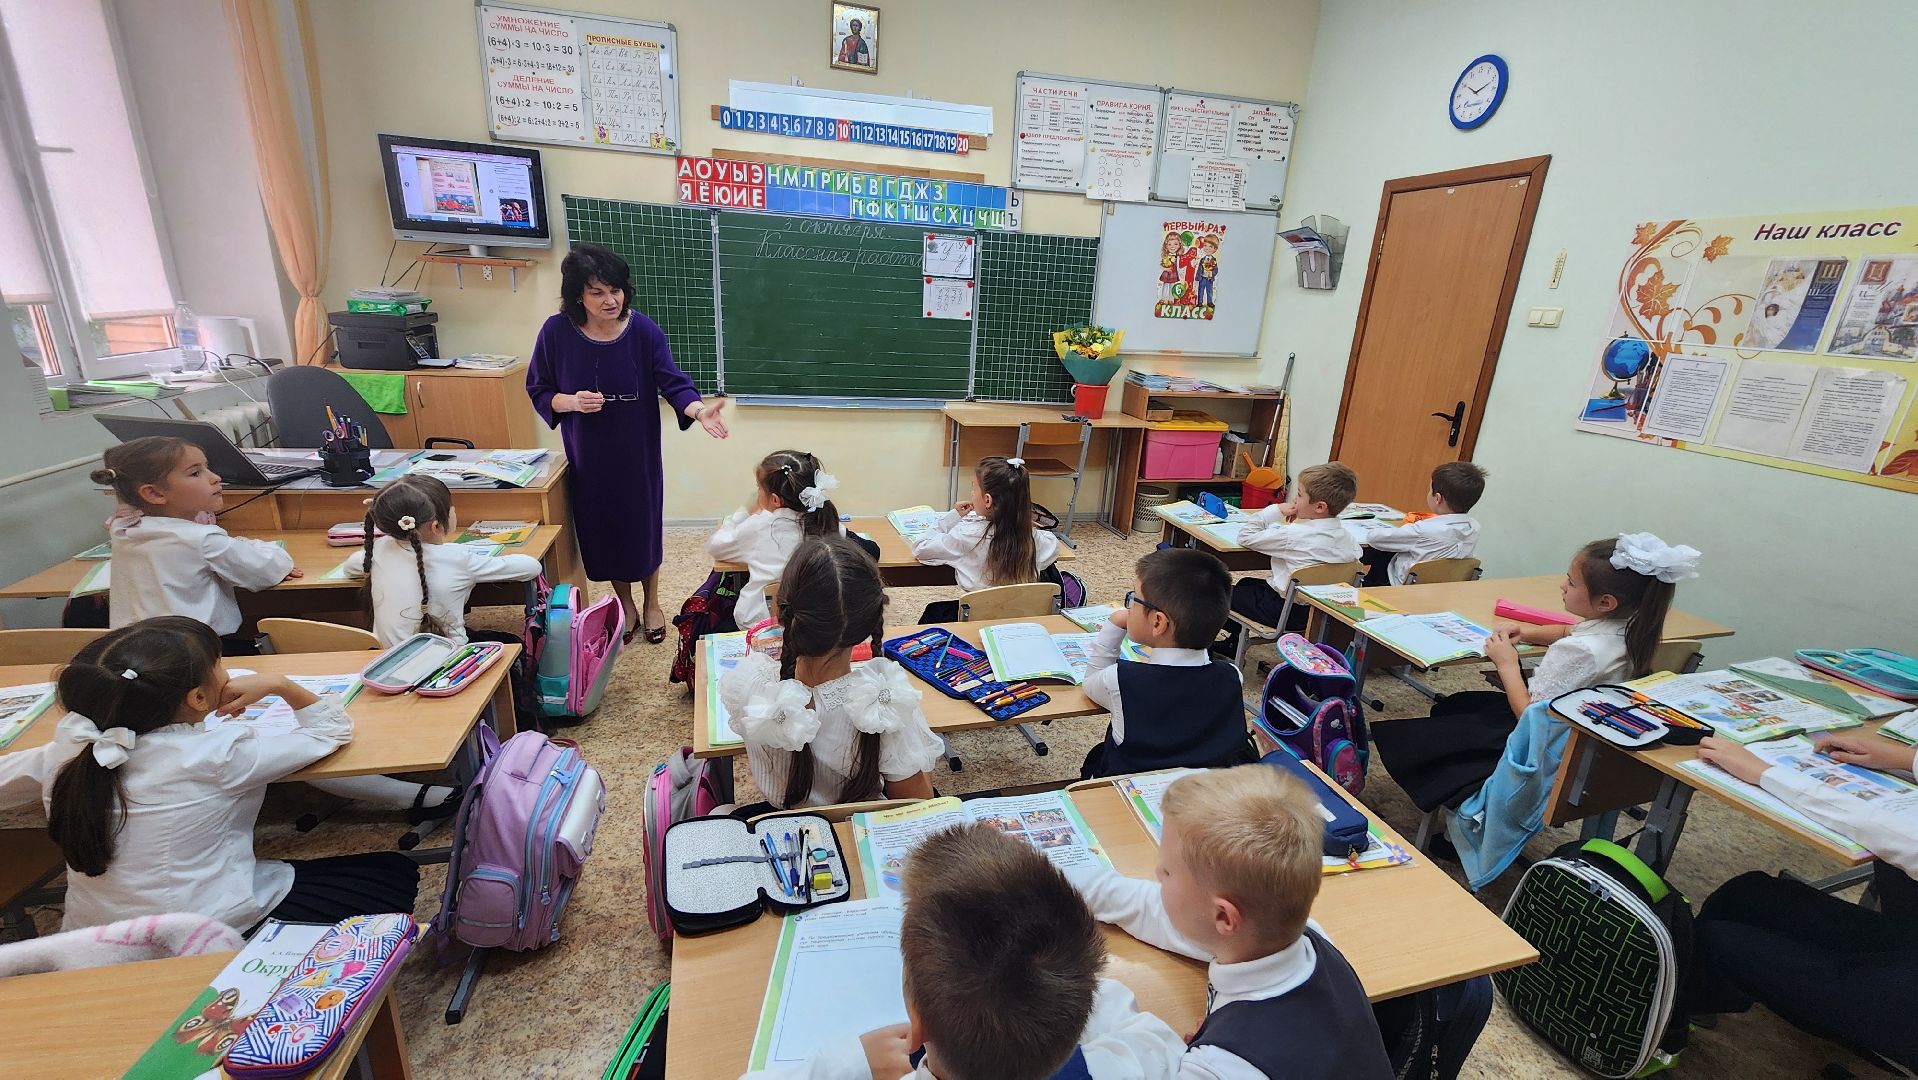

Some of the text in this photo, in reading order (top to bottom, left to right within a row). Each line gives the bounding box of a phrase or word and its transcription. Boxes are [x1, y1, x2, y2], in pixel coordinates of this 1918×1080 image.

[496, 15, 560, 28] УМНОЖЕНИЕ
[490, 22, 569, 38] СУММЫ НА ЧИСЛО
[586, 34, 658, 49] ПРОПИСНЫЕ БУКВЫ
[561, 45, 573, 55] 30
[513, 74, 555, 85] ДЕЛЕНИЕ
[497, 81, 530, 90] СУММЫ
[545, 86, 574, 94] ЧИСЛО
[1032, 87, 1057, 95] ЧАСТИ
[572, 103, 578, 112] 5
[1097, 100, 1128, 108] ПРАВИЛА
[723, 110, 968, 152] 0 1 2 3 4 5 6 7 8 9 10 11 12 13 14 15 16 17 18 19 20
[678, 159, 1020, 208] А О У Ы Э Н М Л Р Й Б В Г Д Ж З Ь
[681, 182, 1017, 229] Я Ё Ю И Е П Ф К Т Ш С Х Ц Ч Щ Ъ
[1164, 220, 1206, 232] ПЕРВЫЙ
[1753, 219, 1902, 242] Наш класс
[755, 229, 853, 259] Классная
[1161, 305, 1207, 319] КЛАСС
